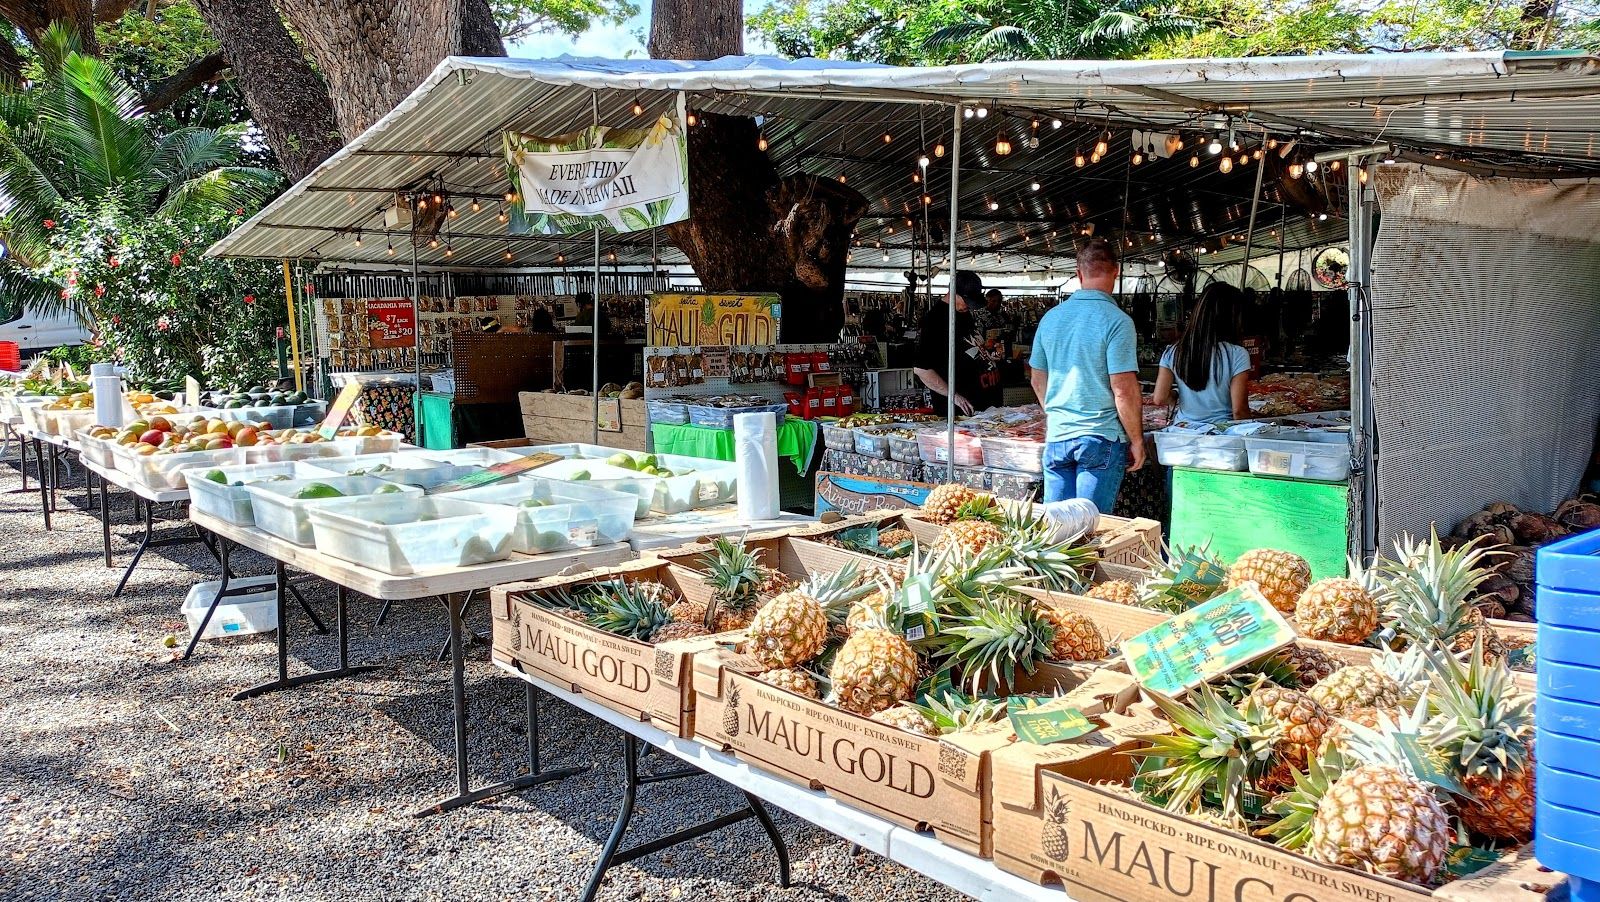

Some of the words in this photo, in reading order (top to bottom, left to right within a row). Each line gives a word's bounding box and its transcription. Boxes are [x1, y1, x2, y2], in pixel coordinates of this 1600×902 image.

[586, 174, 637, 205] HAWAII
[652, 309, 699, 346] MAUI
[822, 481, 870, 516] Airport
[1209, 618, 1239, 646] GOLD
[1227, 607, 1261, 636] MAUI
[525, 623, 578, 670] MAUI
[582, 649, 650, 693] GOLD
[602, 639, 620, 651] EXTRA
[757, 689, 801, 712] HAND-PICKED
[806, 708, 822, 720] RIPE
[823, 714, 835, 724] ON
[864, 727, 891, 743] EXTRA
[892, 737, 922, 752] SWEET
[746, 703, 825, 763] MAUI
[833, 738, 935, 799] GOLD
[1030, 853, 1048, 866] GROWN
[1080, 819, 1222, 902] MAUI
[1098, 803, 1176, 837] HAND-PICKED
[1185, 832, 1215, 850] RIPE
[1218, 843, 1238, 858] ON
[1290, 864, 1338, 890] EXTRA
[1341, 881, 1395, 902] SWEET
